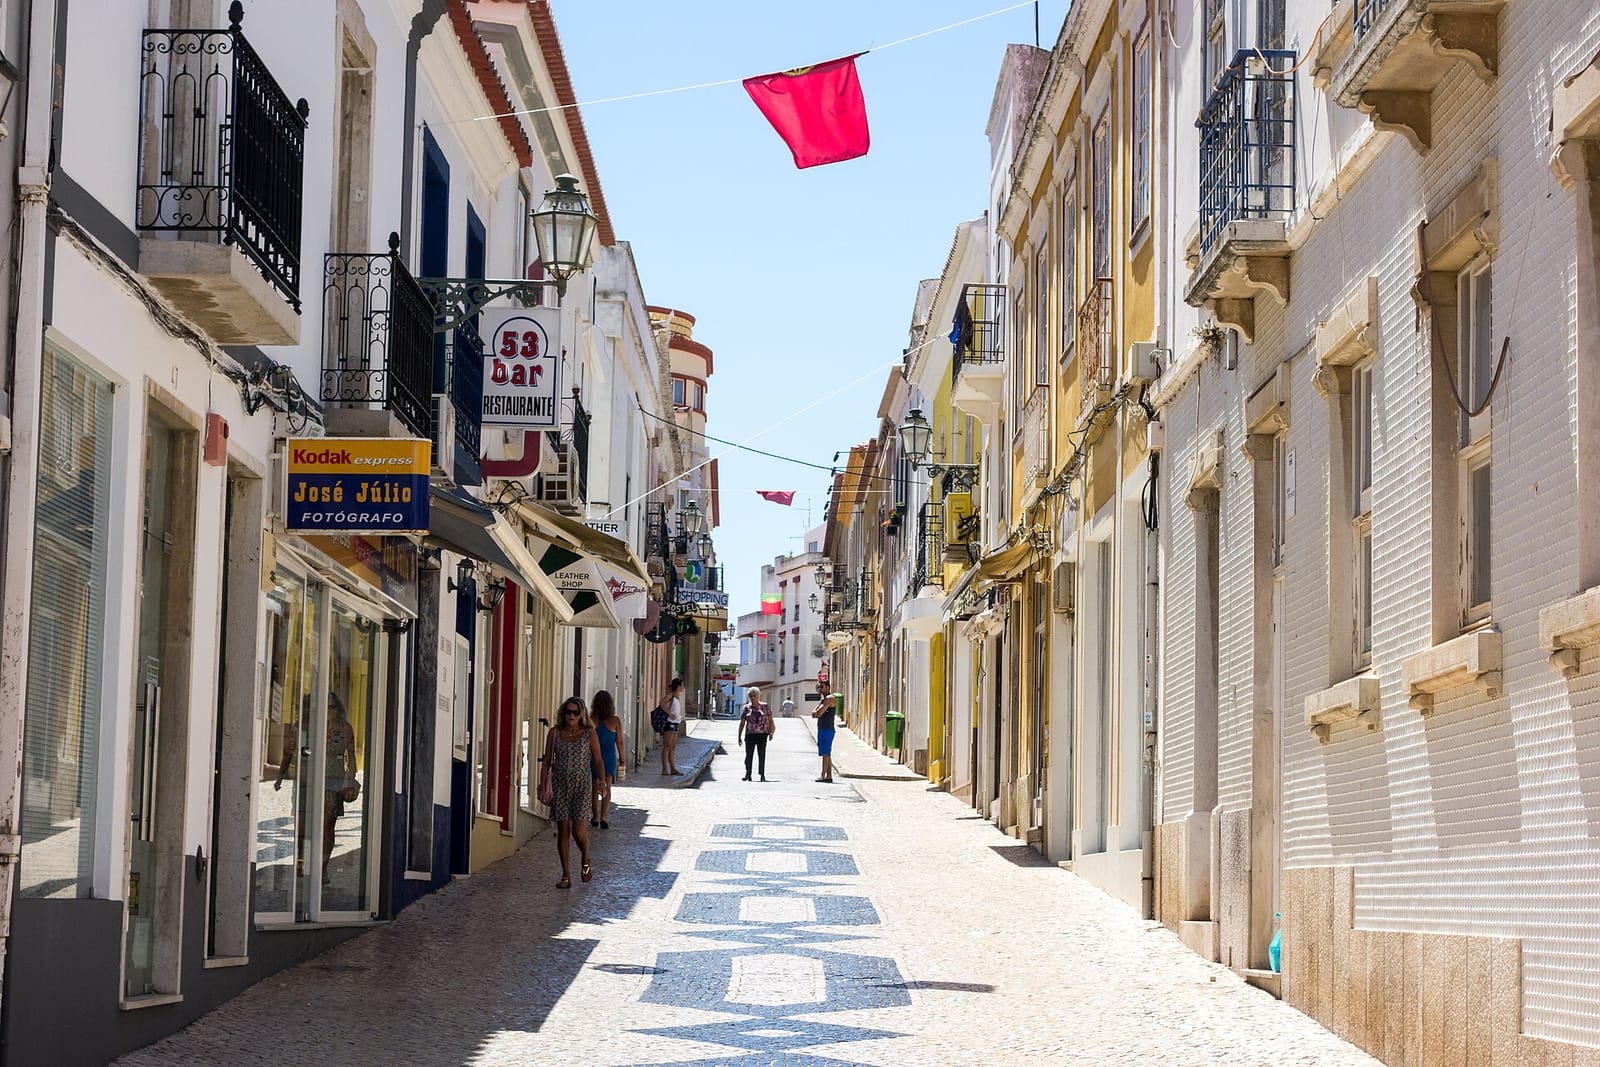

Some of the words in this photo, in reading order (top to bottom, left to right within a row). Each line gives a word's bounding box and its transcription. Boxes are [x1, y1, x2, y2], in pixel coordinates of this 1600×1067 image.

[499, 331, 540, 360] 53
[491, 358, 543, 387] bar
[482, 395, 553, 417] RESTAURANTE
[293, 449, 352, 465] Kodak
[354, 456, 414, 467] express
[294, 480, 343, 503] José
[355, 480, 412, 503] Júlio
[301, 510, 404, 523] FOTÓGRAFO
[554, 572, 590, 581] LEATHER
[561, 580, 583, 588] SHOP
[666, 601, 697, 613] HOSTEL
